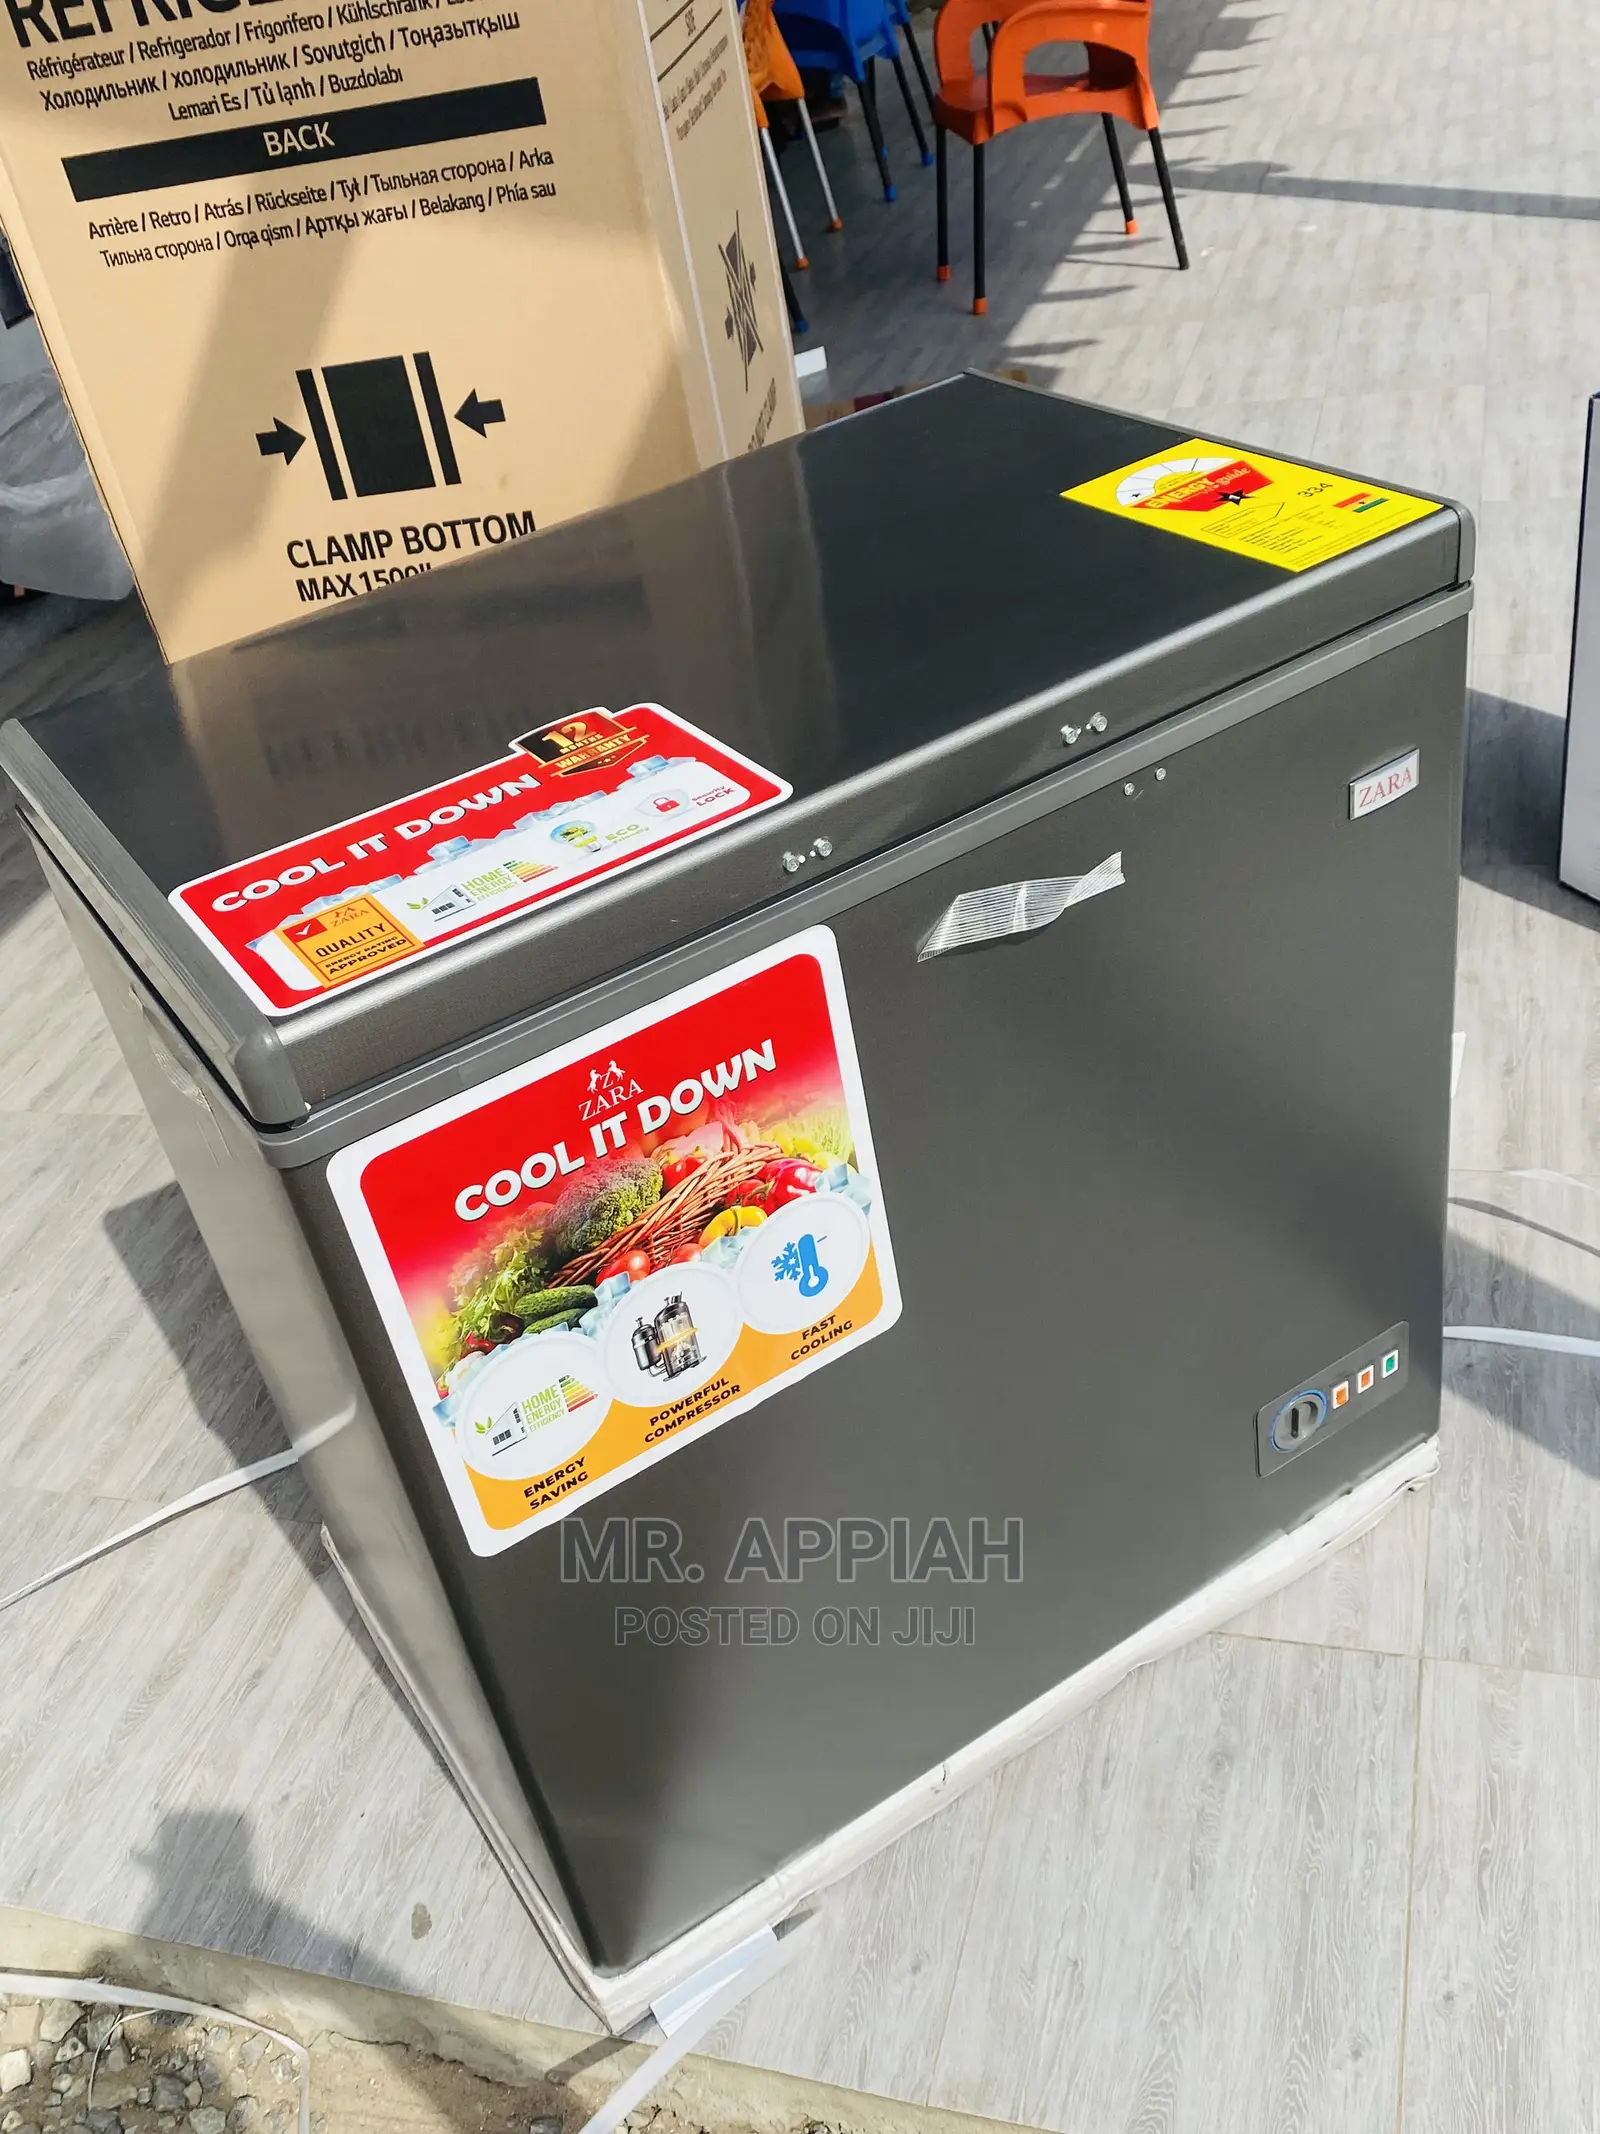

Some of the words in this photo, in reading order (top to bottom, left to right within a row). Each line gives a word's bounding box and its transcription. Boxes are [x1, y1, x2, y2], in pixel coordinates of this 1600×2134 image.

[26, 49, 125, 80] Réfrigérateur
[136, 28, 231, 60] Refrigerador
[243, 12, 324, 44] Frigorifero
[40, 75, 160, 111] Холодильник
[171, 52, 291, 88] холодильник
[301, 31, 385, 65] Sovutgich
[168, 95, 220, 121] Lemari
[220, 92, 241, 113] Es
[276, 76, 316, 106] lạnh
[262, 121, 336, 157] BACK
[89, 216, 139, 240] Arrière
[149, 209, 191, 230] Retro
[204, 198, 245, 221] Atrás
[254, 186, 327, 212] Rückseite
[370, 168, 439, 193] Тыльная
[440, 157, 507, 182] сторона
[519, 148, 554, 169] Arka
[100, 247, 153, 268] Тильна
[155, 236, 214, 260] сторона
[224, 229, 260, 251] Orqa
[260, 224, 294, 247] qism
[419, 192, 486, 217] Belakang
[496, 183, 529, 204] Phía
[530, 181, 557, 199] sau
[1216, 466, 1251, 486] guide
[1297, 482, 1334, 498] 334
[286, 528, 394, 569] CLAMP
[400, 509, 537, 556] BOTTOM
[295, 573, 359, 603] MAX
[541, 721, 591, 749] 12
[554, 734, 633, 770] WARRANTY
[559, 732, 605, 755] MONTHS
[695, 786, 736, 807] LOCK
[1358, 766, 1412, 809] ZARA
[211, 856, 347, 914] COOL
[346, 832, 389, 861] IT
[394, 773, 542, 842] DOWN
[604, 823, 641, 842] ECO
[461, 866, 507, 891] HOME
[469, 874, 514, 897] ENERGY
[315, 922, 387, 959] QUALITY
[325, 950, 358, 968] ENERGY
[357, 935, 399, 956] RATING
[328, 938, 407, 975] APPROVED
[578, 1078, 644, 1121] ZARA
[454, 1140, 585, 1222] COOL
[589, 1110, 628, 1158] IT
[636, 1038, 778, 1135] DOWN
[790, 1319, 854, 1362] COOLING
[801, 1313, 838, 1341] FAST
[521, 1383, 560, 1415] HOME
[525, 1397, 562, 1424] ENERGY
[643, 1383, 742, 1445] COMPRESSOR
[648, 1376, 730, 1427] POWERFUL
[528, 1408, 566, 1433] EFFICIENCY
[523, 1455, 587, 1499] ENERGY
[529, 1470, 589, 1511] SAVING
